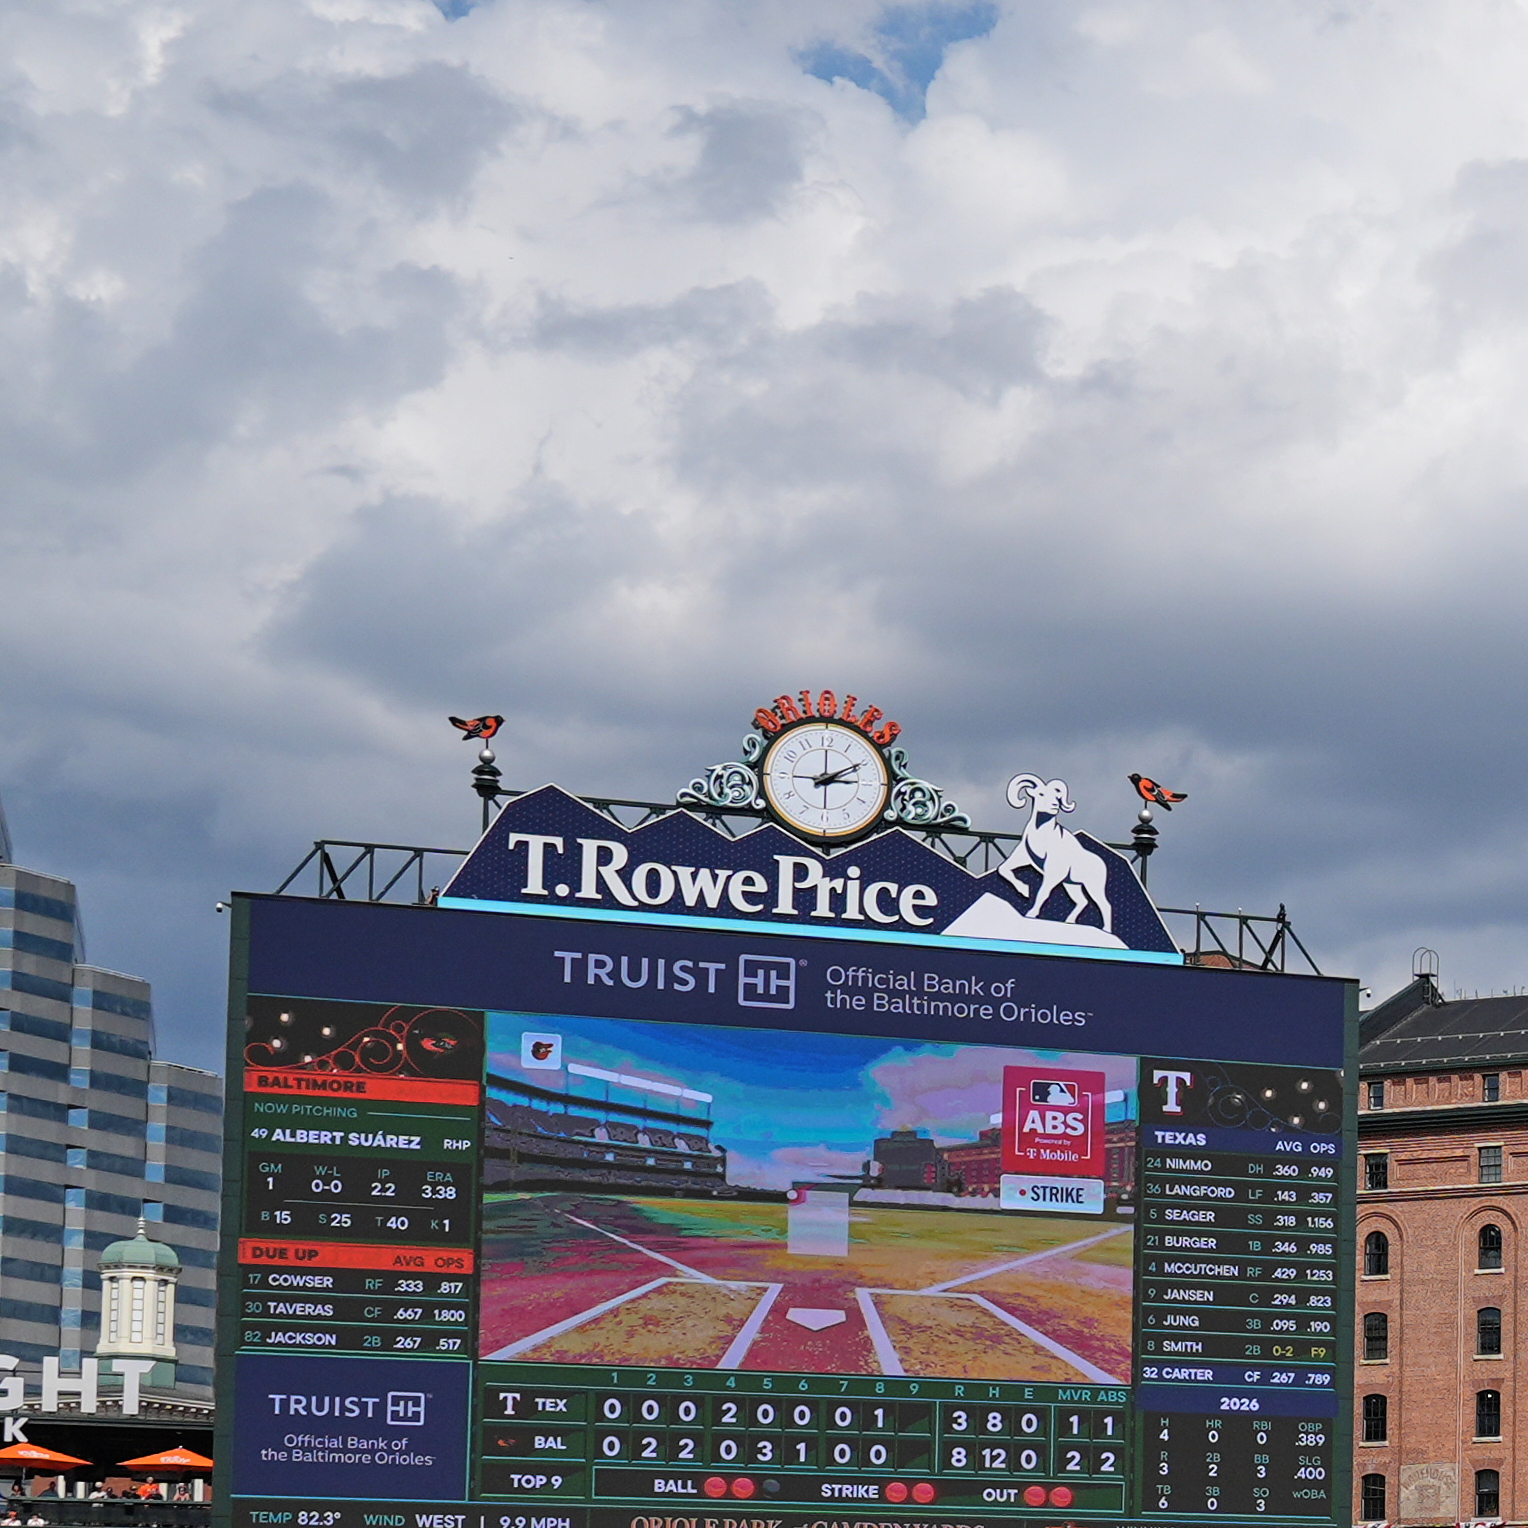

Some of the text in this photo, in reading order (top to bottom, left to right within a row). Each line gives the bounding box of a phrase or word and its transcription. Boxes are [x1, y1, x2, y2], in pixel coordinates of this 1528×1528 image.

[754, 690, 902, 744] ORIOLES
[773, 854, 938, 927] Price
[554, 951, 725, 993] TRUIST
[825, 965, 1015, 998] Official Bank of
[825, 989, 1086, 1027] the Baltimore Orioles
[257, 1075, 366, 1093] BALTIMORE
[1153, 1070, 1194, 1115] T
[254, 1102, 358, 1118] NOW PITCHING
[1023, 1110, 1085, 1136] ABS
[251, 1128, 470, 1150] 49 ALBERT SUÁREZ RHP
[1154, 1131, 1336, 1154] TEXAS AVG OPS
[1040, 1149, 1078, 1162] Mobile
[259, 1162, 453, 1183] GM W-L IP ERA
[1166, 1158, 1212, 1172] NIMMO
[311, 1179, 456, 1200] 0-0 2.2 3.38
[1031, 1185, 1084, 1204] STRIKE
[1165, 1184, 1234, 1198] LANGFORD
[1165, 1209, 1216, 1222] SEAGER
[1164, 1236, 1217, 1249] BURGER
[252, 1247, 464, 1269] DUE UP AVG OPS
[1164, 1262, 1239, 1276] MCCUTCHEN
[248, 1273, 463, 1294] 17 COWSER RF .333 .817
[1163, 1289, 1214, 1302] JANSEN
[245, 1301, 465, 1322] 30 TAVERAS CF .667 1.800
[1163, 1315, 1200, 1327] JUNG
[244, 1331, 461, 1350] 82 JACKSON 2B .267 .517
[1163, 1340, 1202, 1353] SMITH
[1143, 1367, 1330, 1385] 32 CARTER CF .267 .789
[1058, 1389, 1127, 1402] MVR ABS
[1220, 1398, 1260, 1411] 2026
[268, 1394, 380, 1418] TRUIST
[535, 1398, 568, 1412] TEX
[283, 1434, 408, 1451] Official Bank of
[534, 1436, 566, 1450] BAL
[261, 1448, 433, 1466] the Baltimore Orioles
[510, 1474, 562, 1489] TOP 9
[654, 1479, 1018, 1502] BALL STRIKE OUT
[250, 1512, 292, 1524] TEMP
[364, 1514, 405, 1527] WIND
[415, 1514, 465, 1528] WEST
